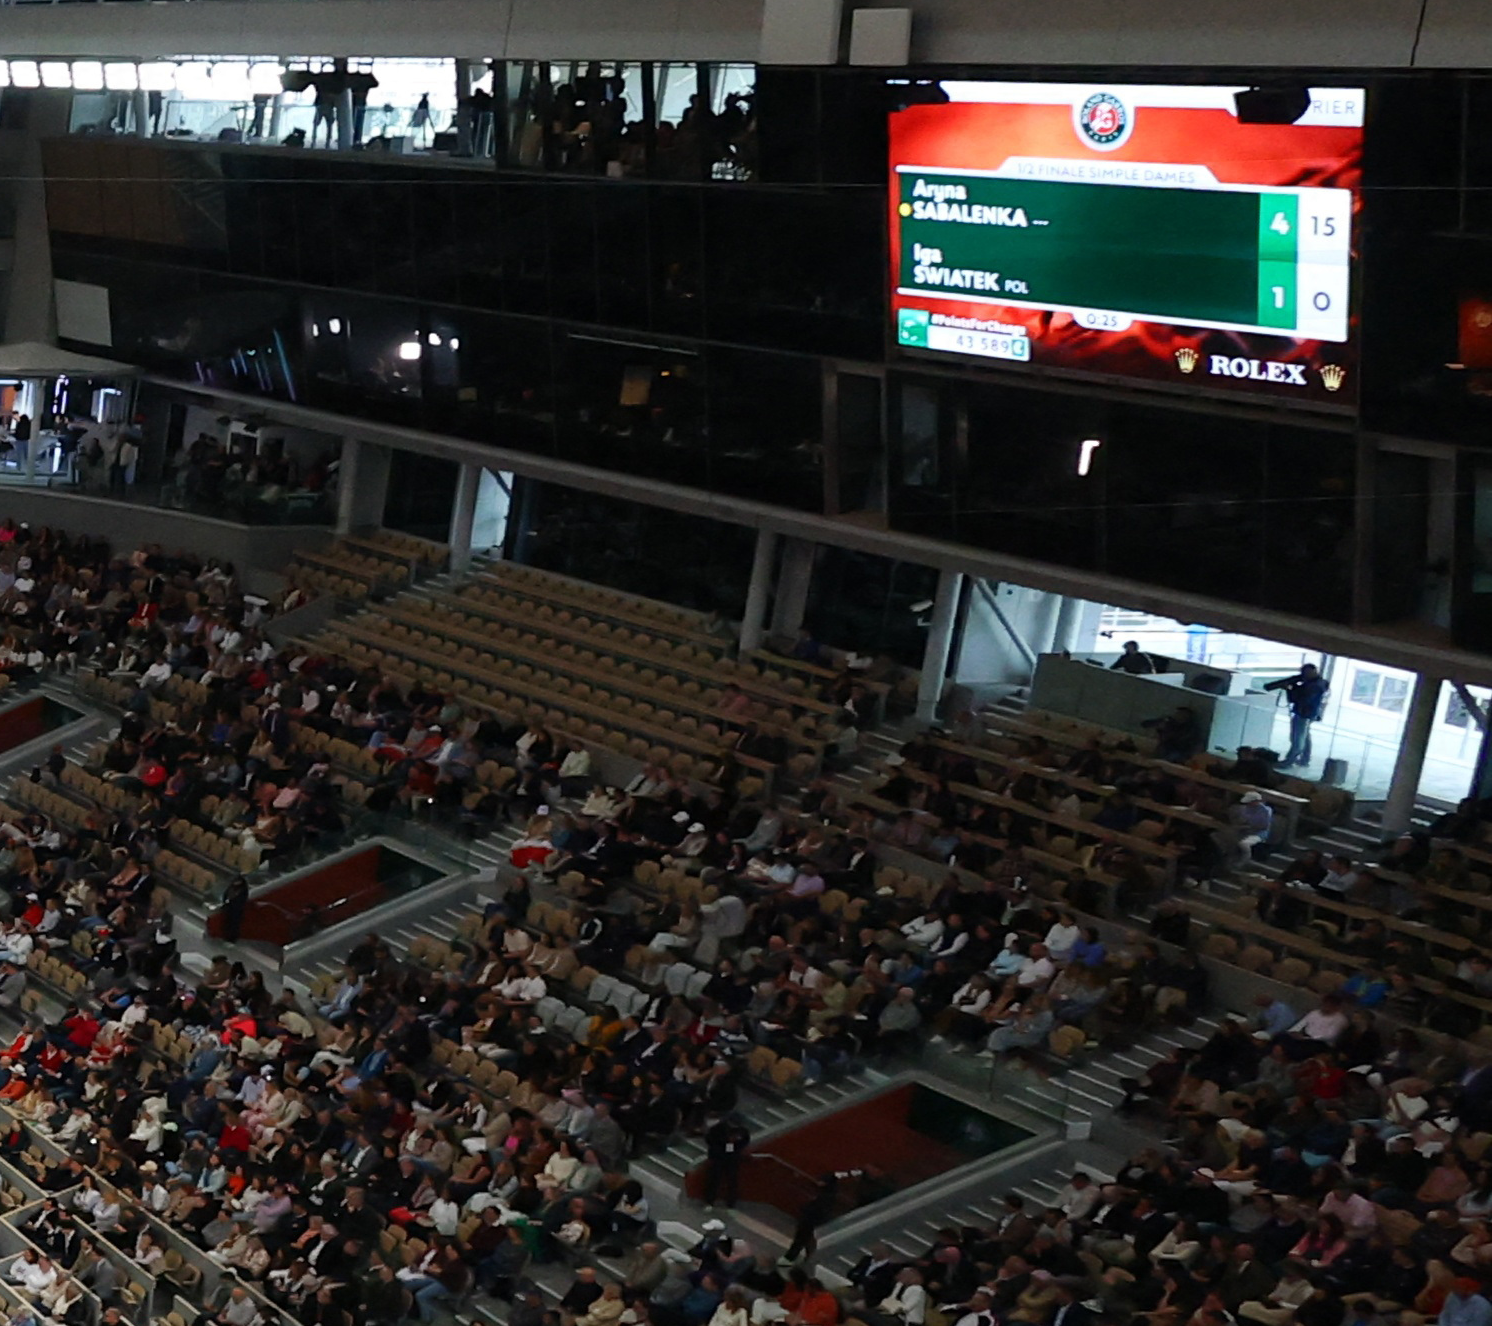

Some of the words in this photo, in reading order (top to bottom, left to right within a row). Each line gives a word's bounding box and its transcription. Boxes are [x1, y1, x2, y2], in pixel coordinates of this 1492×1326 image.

[1018, 163, 1034, 175] 1/2
[1039, 164, 1084, 177] FINALE
[1089, 167, 1139, 181] SIMPLE
[1143, 170, 1195, 183] DAMES
[912, 178, 967, 203] Aryna
[912, 200, 1028, 227] SABALENKA
[1269, 212, 1291, 235] 4
[1310, 215, 1336, 237] 15
[913, 242, 943, 266] Iga
[913, 265, 1001, 292] SWIATEK
[1004, 279, 1029, 295] POL
[1271, 286, 1285, 309] 1
[1086, 312, 1118, 328] 0:25
[956, 334, 974, 348] 43
[980, 337, 1010, 353] 589
[1210, 354, 1308, 385] ROLEX
